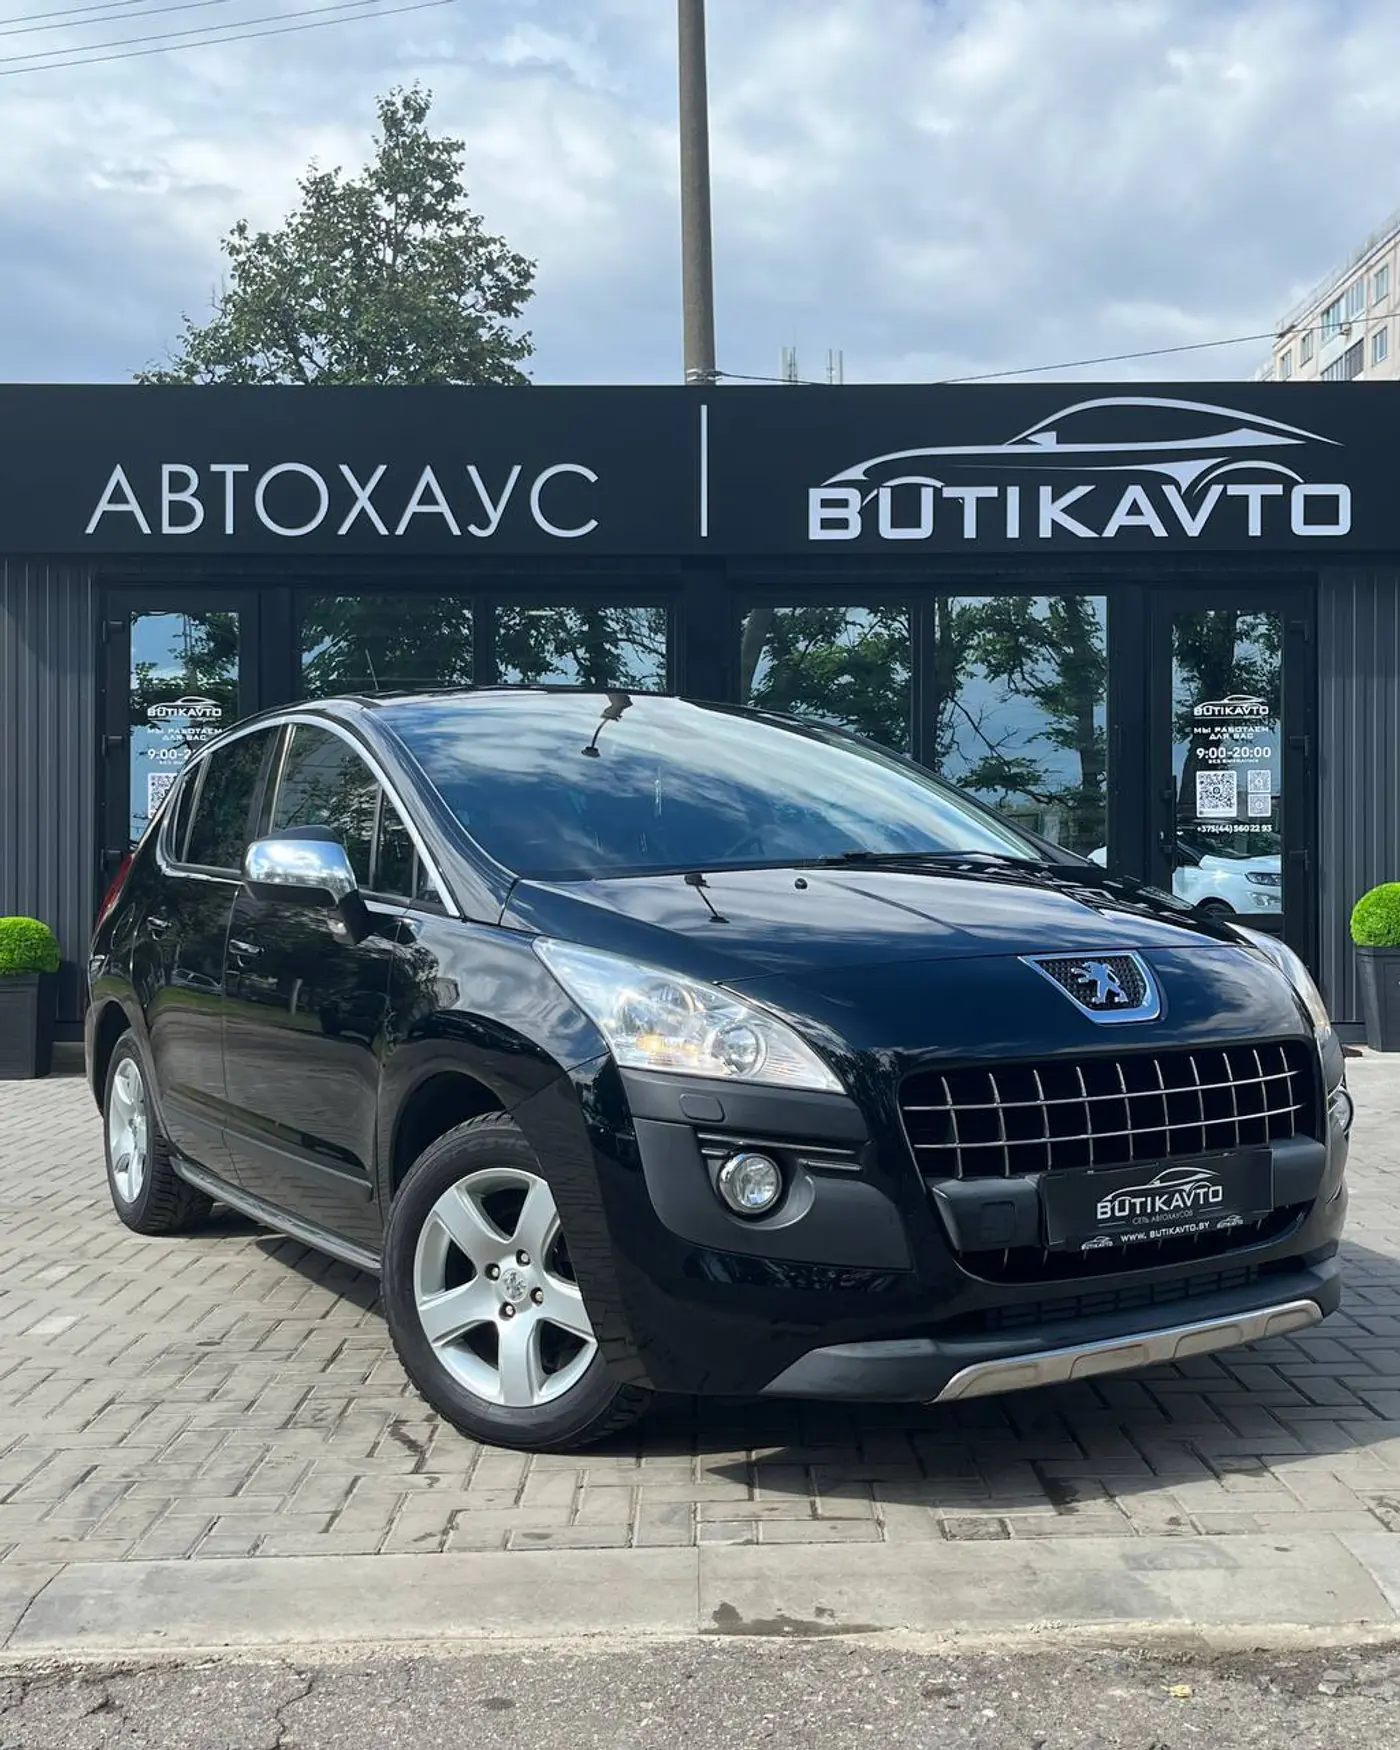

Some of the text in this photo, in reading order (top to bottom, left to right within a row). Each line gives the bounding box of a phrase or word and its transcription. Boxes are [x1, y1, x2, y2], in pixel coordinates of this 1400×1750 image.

[85, 463, 599, 538] АВТОХАУС
[807, 483, 1352, 541] BUTIKAVTO
[146, 707, 222, 717] BUTIKAVTO
[1193, 705, 1269, 716] BUTIKAVTO
[1196, 746, 1271, 759] 9:00-20:00
[1096, 1185, 1223, 1220] BUTIKAVTO
